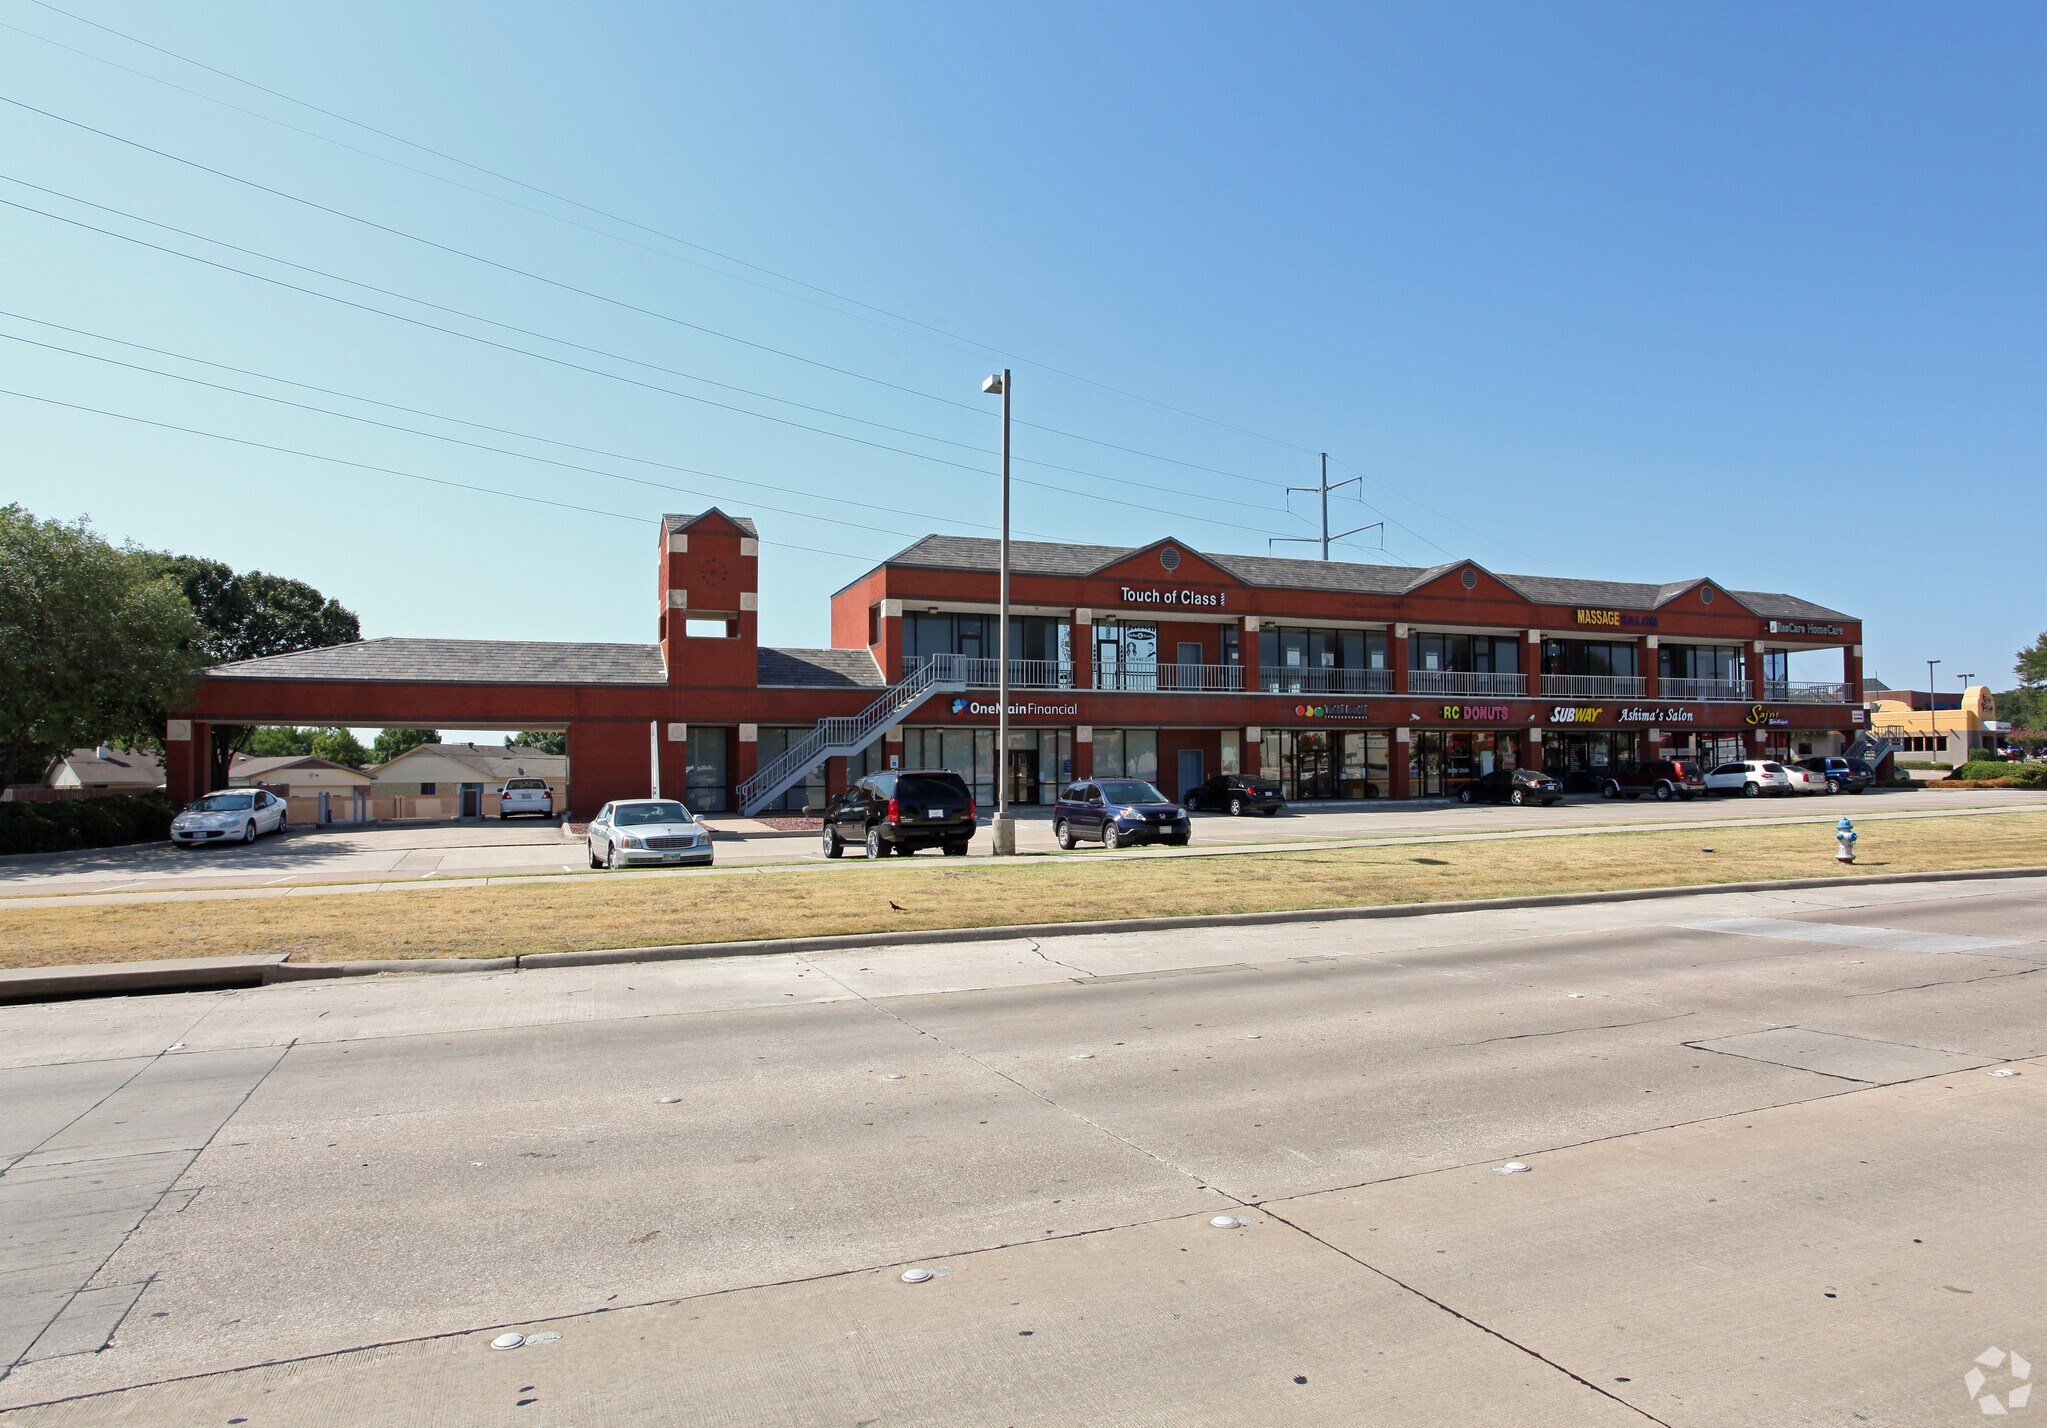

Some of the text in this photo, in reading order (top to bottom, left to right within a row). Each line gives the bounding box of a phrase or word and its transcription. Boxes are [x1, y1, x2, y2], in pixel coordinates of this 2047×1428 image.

[1121, 587, 1217, 606] Touch of Class
[1577, 609, 1620, 626] MASSAGE
[1807, 623, 1844, 635] HomeCare
[1443, 705, 1509, 720] RC DONUTS
[1550, 706, 1603, 723] SUBWAY
[1618, 707, 1694, 722] Ashima's Salon
